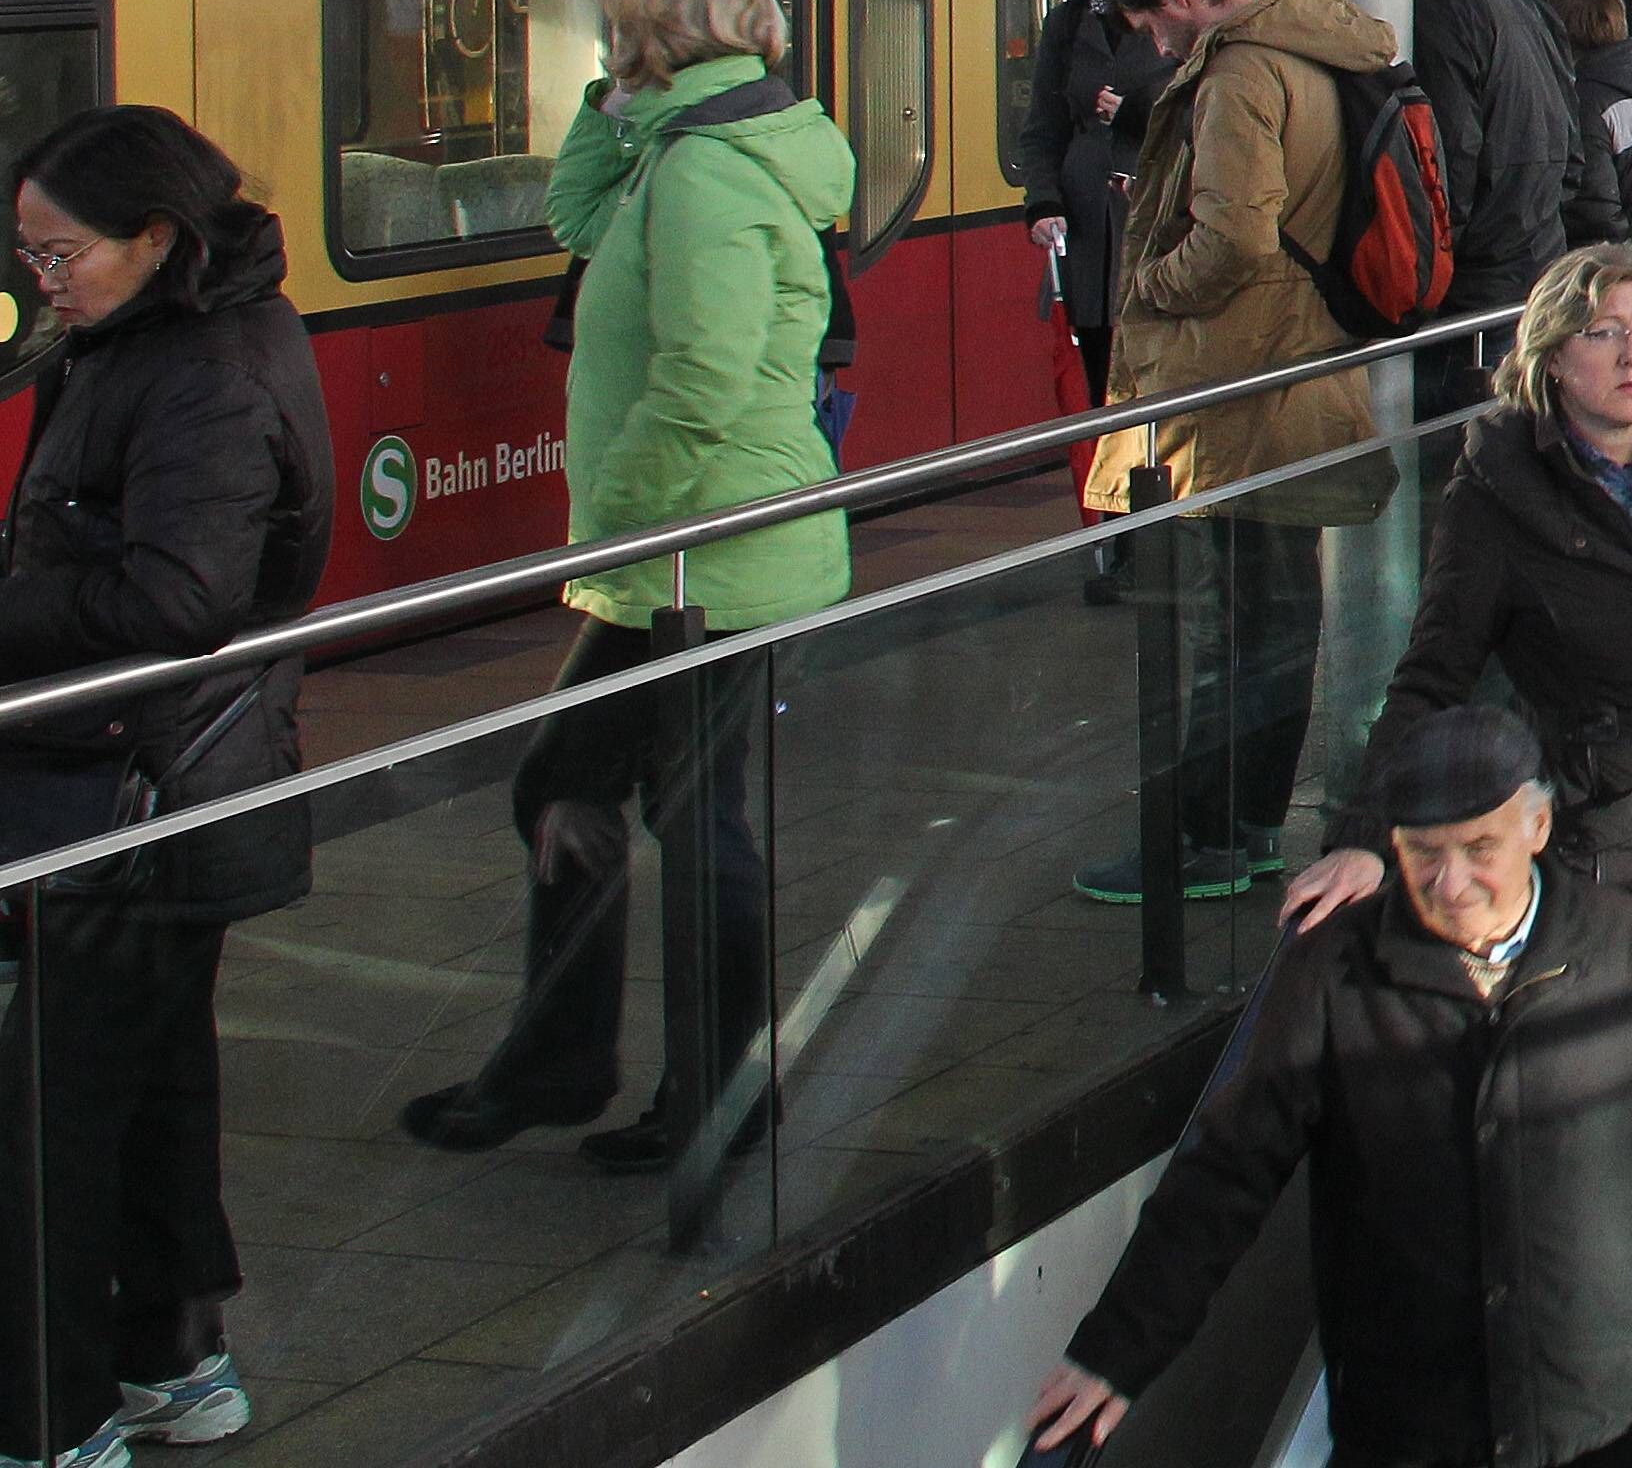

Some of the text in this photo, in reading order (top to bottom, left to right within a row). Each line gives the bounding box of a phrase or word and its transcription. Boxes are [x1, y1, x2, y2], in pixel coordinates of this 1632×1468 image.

[371, 432, 566, 529] S Bahn Berlin
